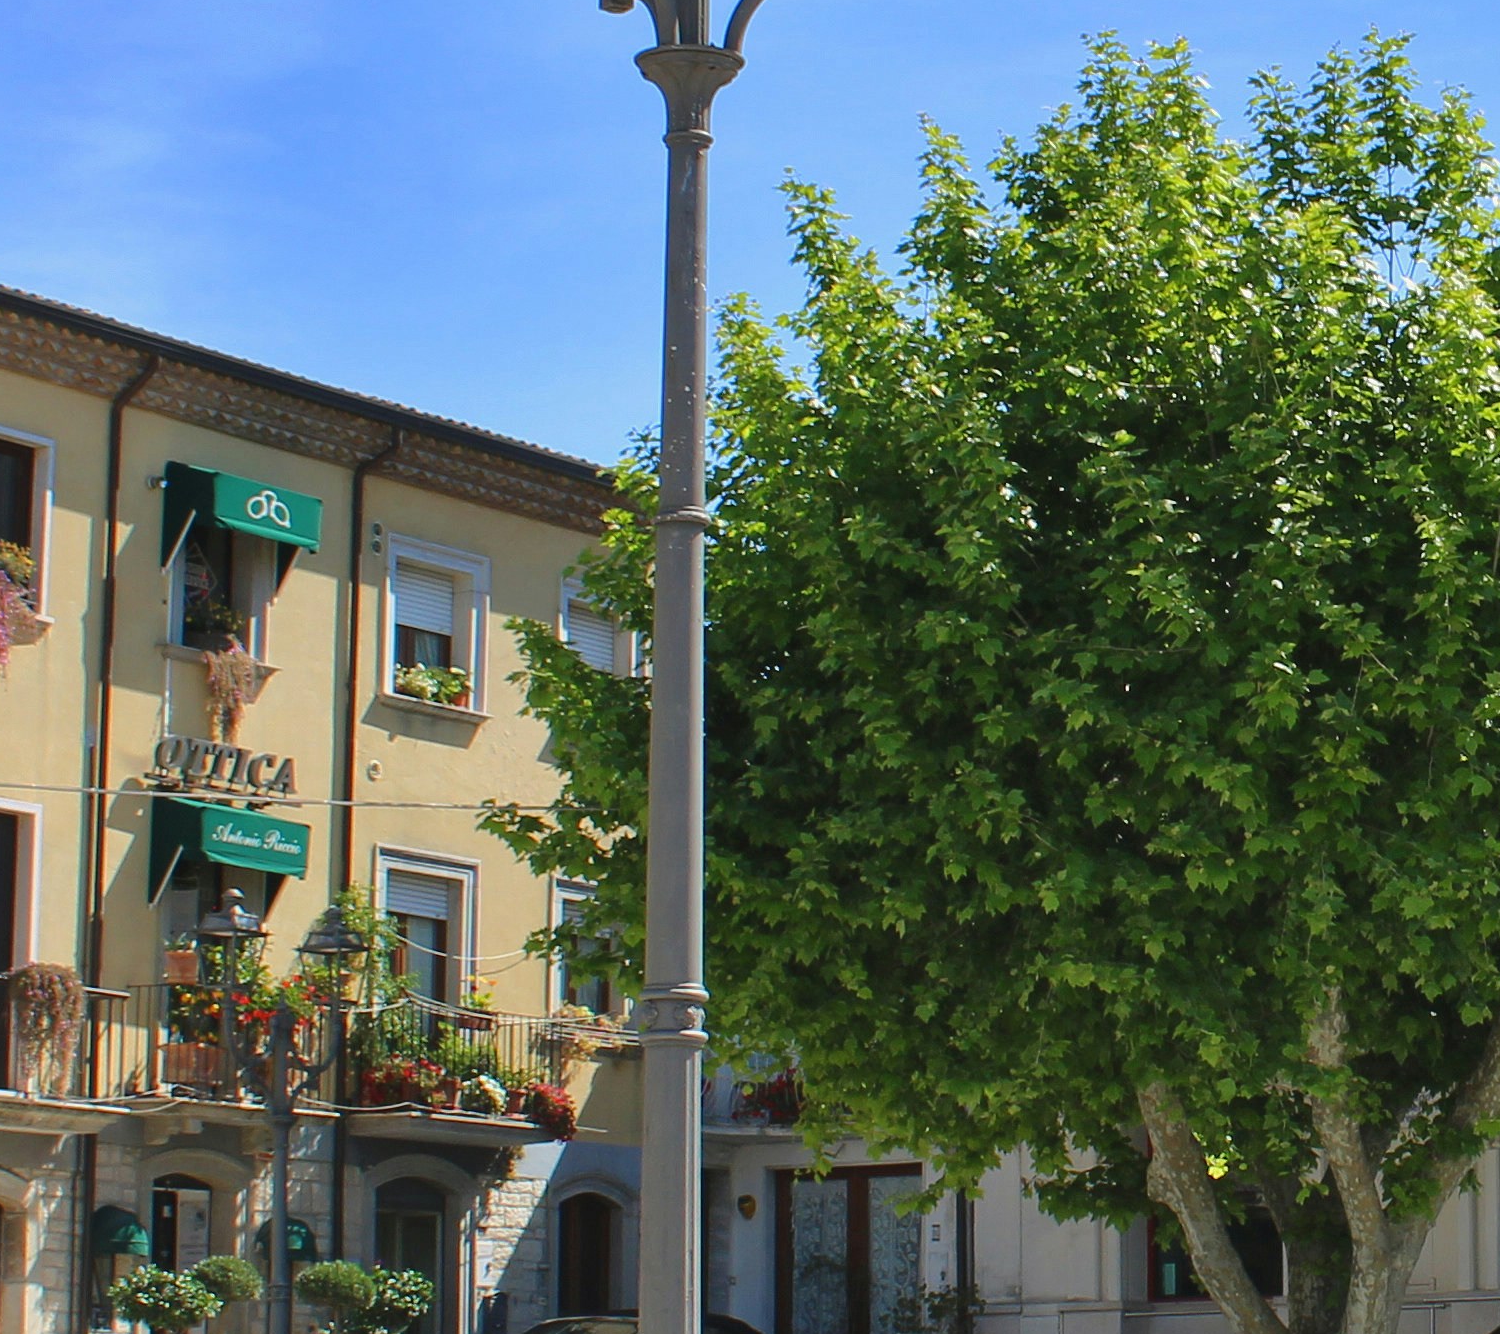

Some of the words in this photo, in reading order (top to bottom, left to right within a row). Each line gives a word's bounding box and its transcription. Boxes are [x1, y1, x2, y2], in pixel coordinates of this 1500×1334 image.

[155, 737, 299, 795] OTTICA
[211, 822, 262, 848] Antonio
[263, 829, 302, 855] Riccio
